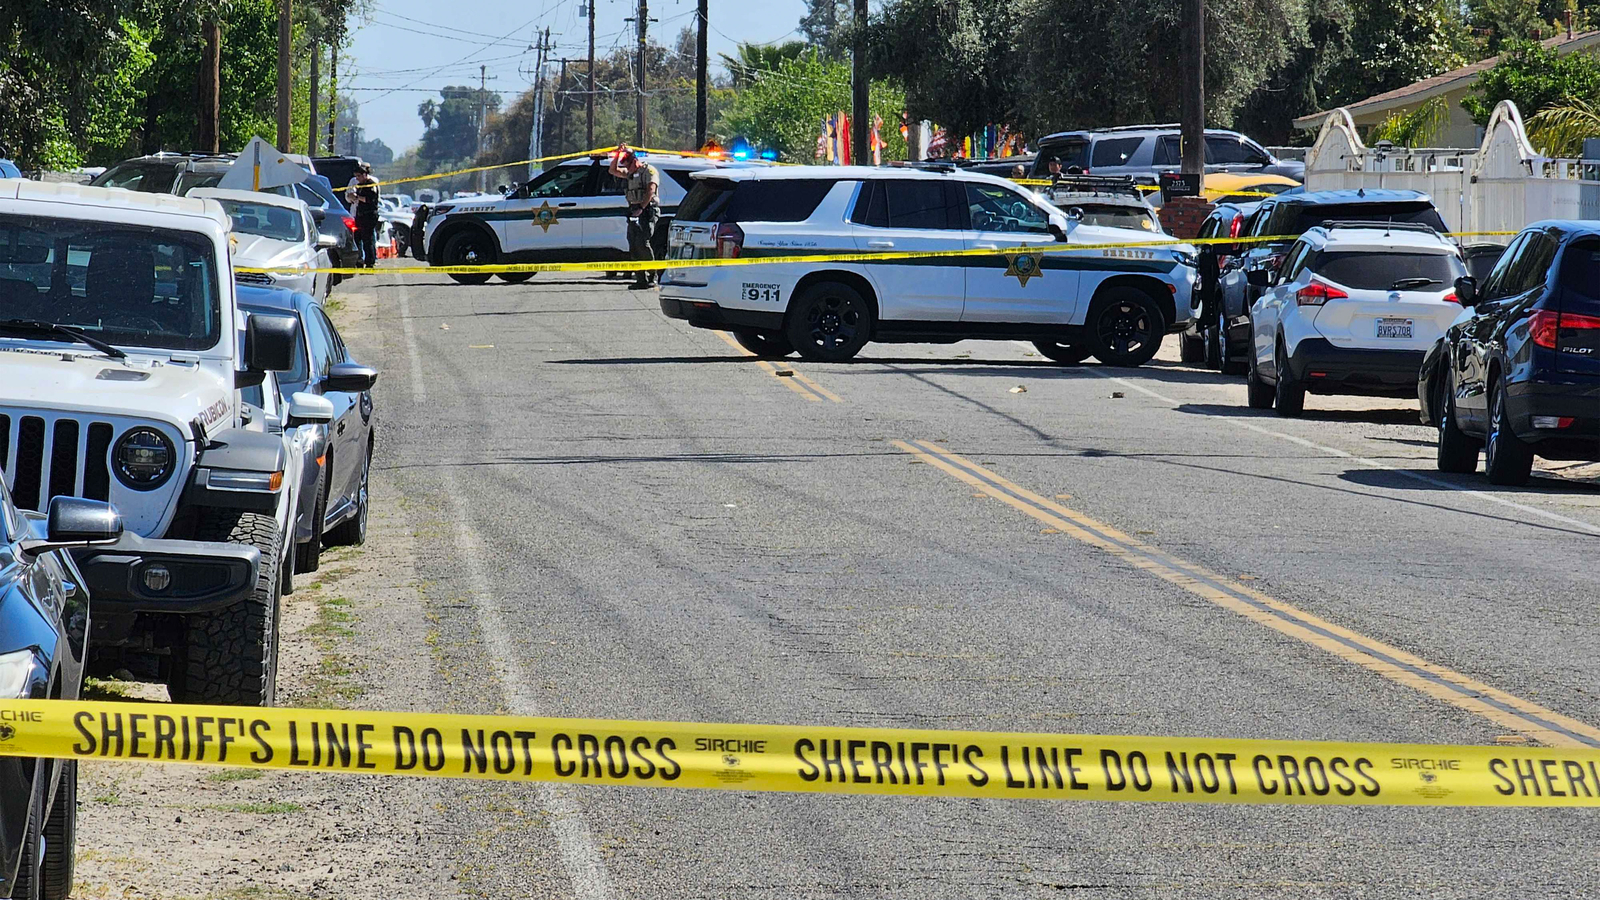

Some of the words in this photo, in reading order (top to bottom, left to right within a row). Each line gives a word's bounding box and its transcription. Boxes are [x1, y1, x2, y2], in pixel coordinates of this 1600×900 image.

[1102, 249, 1155, 259] SHERIFF
[742, 282, 781, 290] EMERGENCY
[1378, 325, 1411, 337] 8VRS708
[1562, 346, 1595, 354] PILOT
[198, 396, 228, 425] RUBICON
[73, 711, 274, 764] SHERIFF'S
[289, 721, 376, 769] LINE
[393, 726, 446, 771] DO
[461, 729, 537, 776] NOT
[551, 733, 682, 781] CROSS
[694, 738, 768, 754] SIRCHIE
[793, 738, 990, 788] SHERIFF'S
[1001, 745, 1089, 791] LINE
[1100, 749, 1153, 793] DO
[1164, 751, 1238, 796] NOT
[1252, 754, 1380, 798] CROSS
[1390, 757, 1463, 770] SIRCHIE
